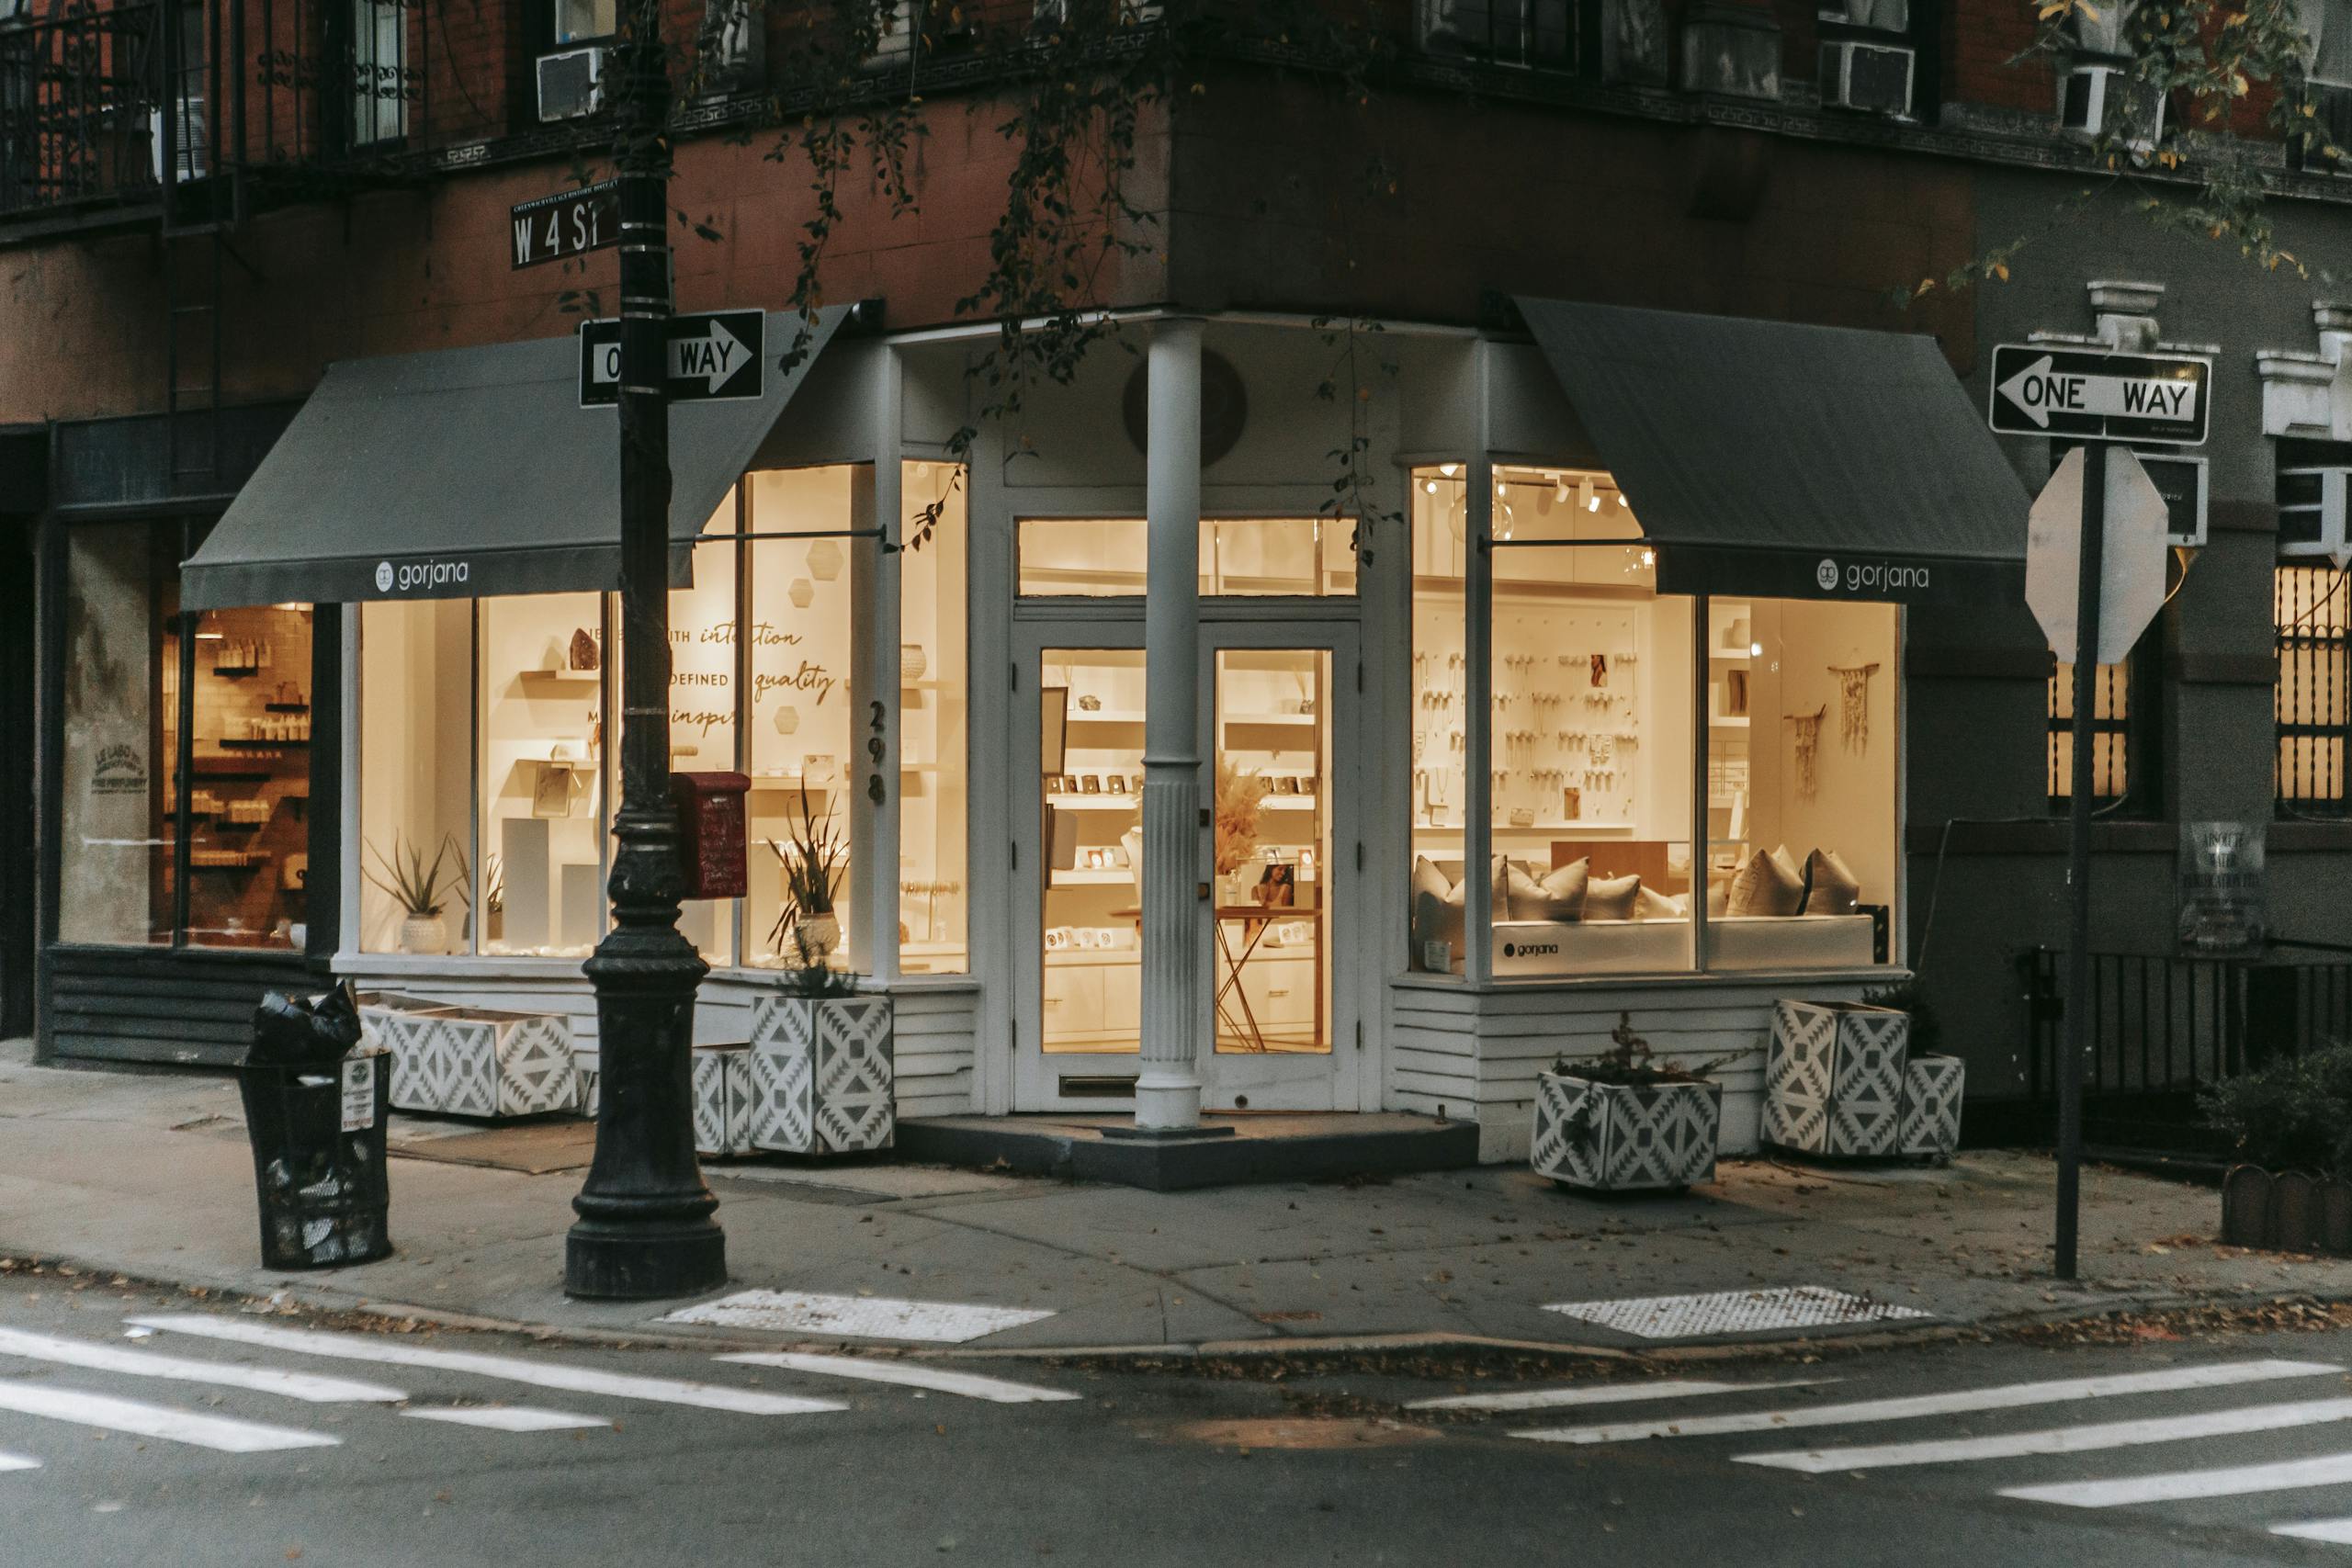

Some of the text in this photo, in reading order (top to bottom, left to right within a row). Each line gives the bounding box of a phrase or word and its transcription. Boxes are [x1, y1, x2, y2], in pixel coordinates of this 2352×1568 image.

[514, 201, 598, 265] W 4 ST
[680, 341, 734, 375] WAY
[2023, 375, 2188, 415] ONE WAY
[399, 559, 469, 591] gorjana
[1847, 561, 1929, 592] gorjana
[670, 621, 803, 646] ITH inttion
[754, 660, 836, 706] quality
[868, 701, 885, 807] 298
[1518, 944, 1558, 957] gorjana
